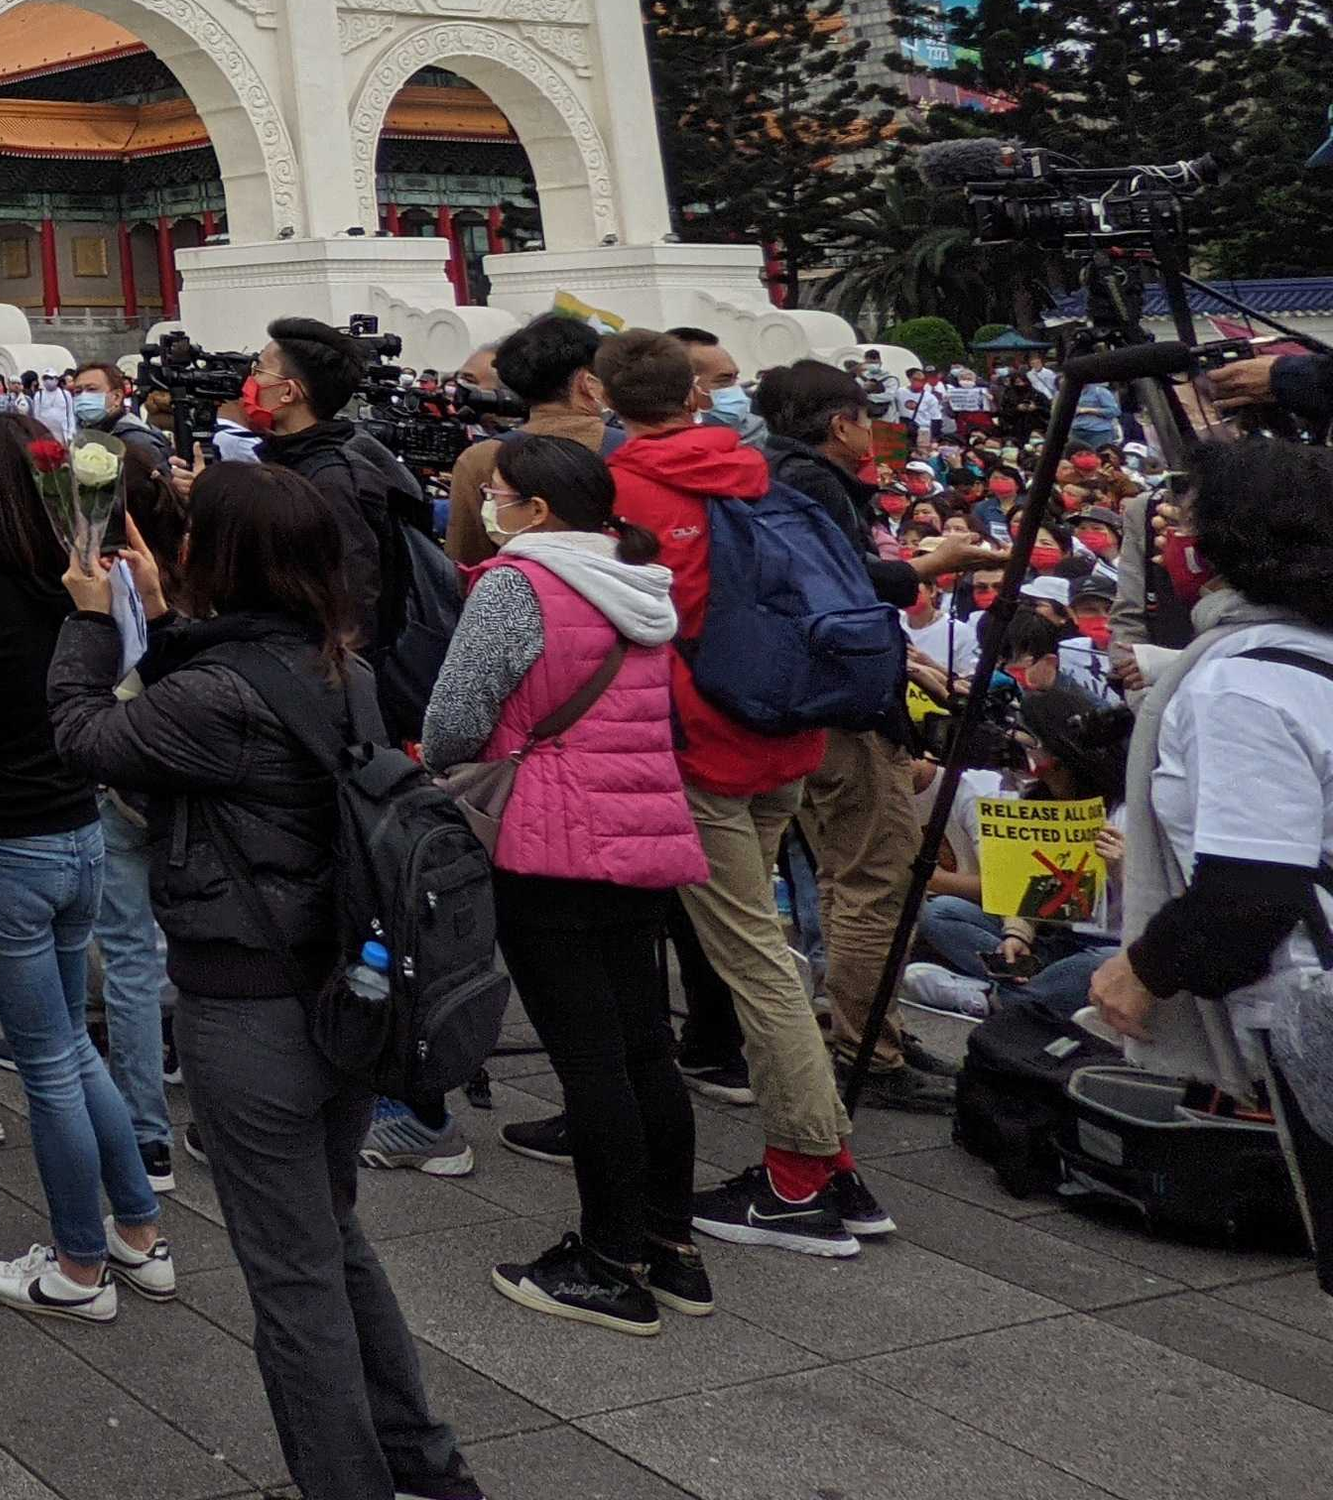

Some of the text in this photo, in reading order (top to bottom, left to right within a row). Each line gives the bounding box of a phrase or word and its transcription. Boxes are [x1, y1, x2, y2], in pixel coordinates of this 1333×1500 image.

[980, 803, 1059, 821] RELEASE
[1064, 806, 1087, 821] ALL
[981, 823, 1061, 843] ELECTED
